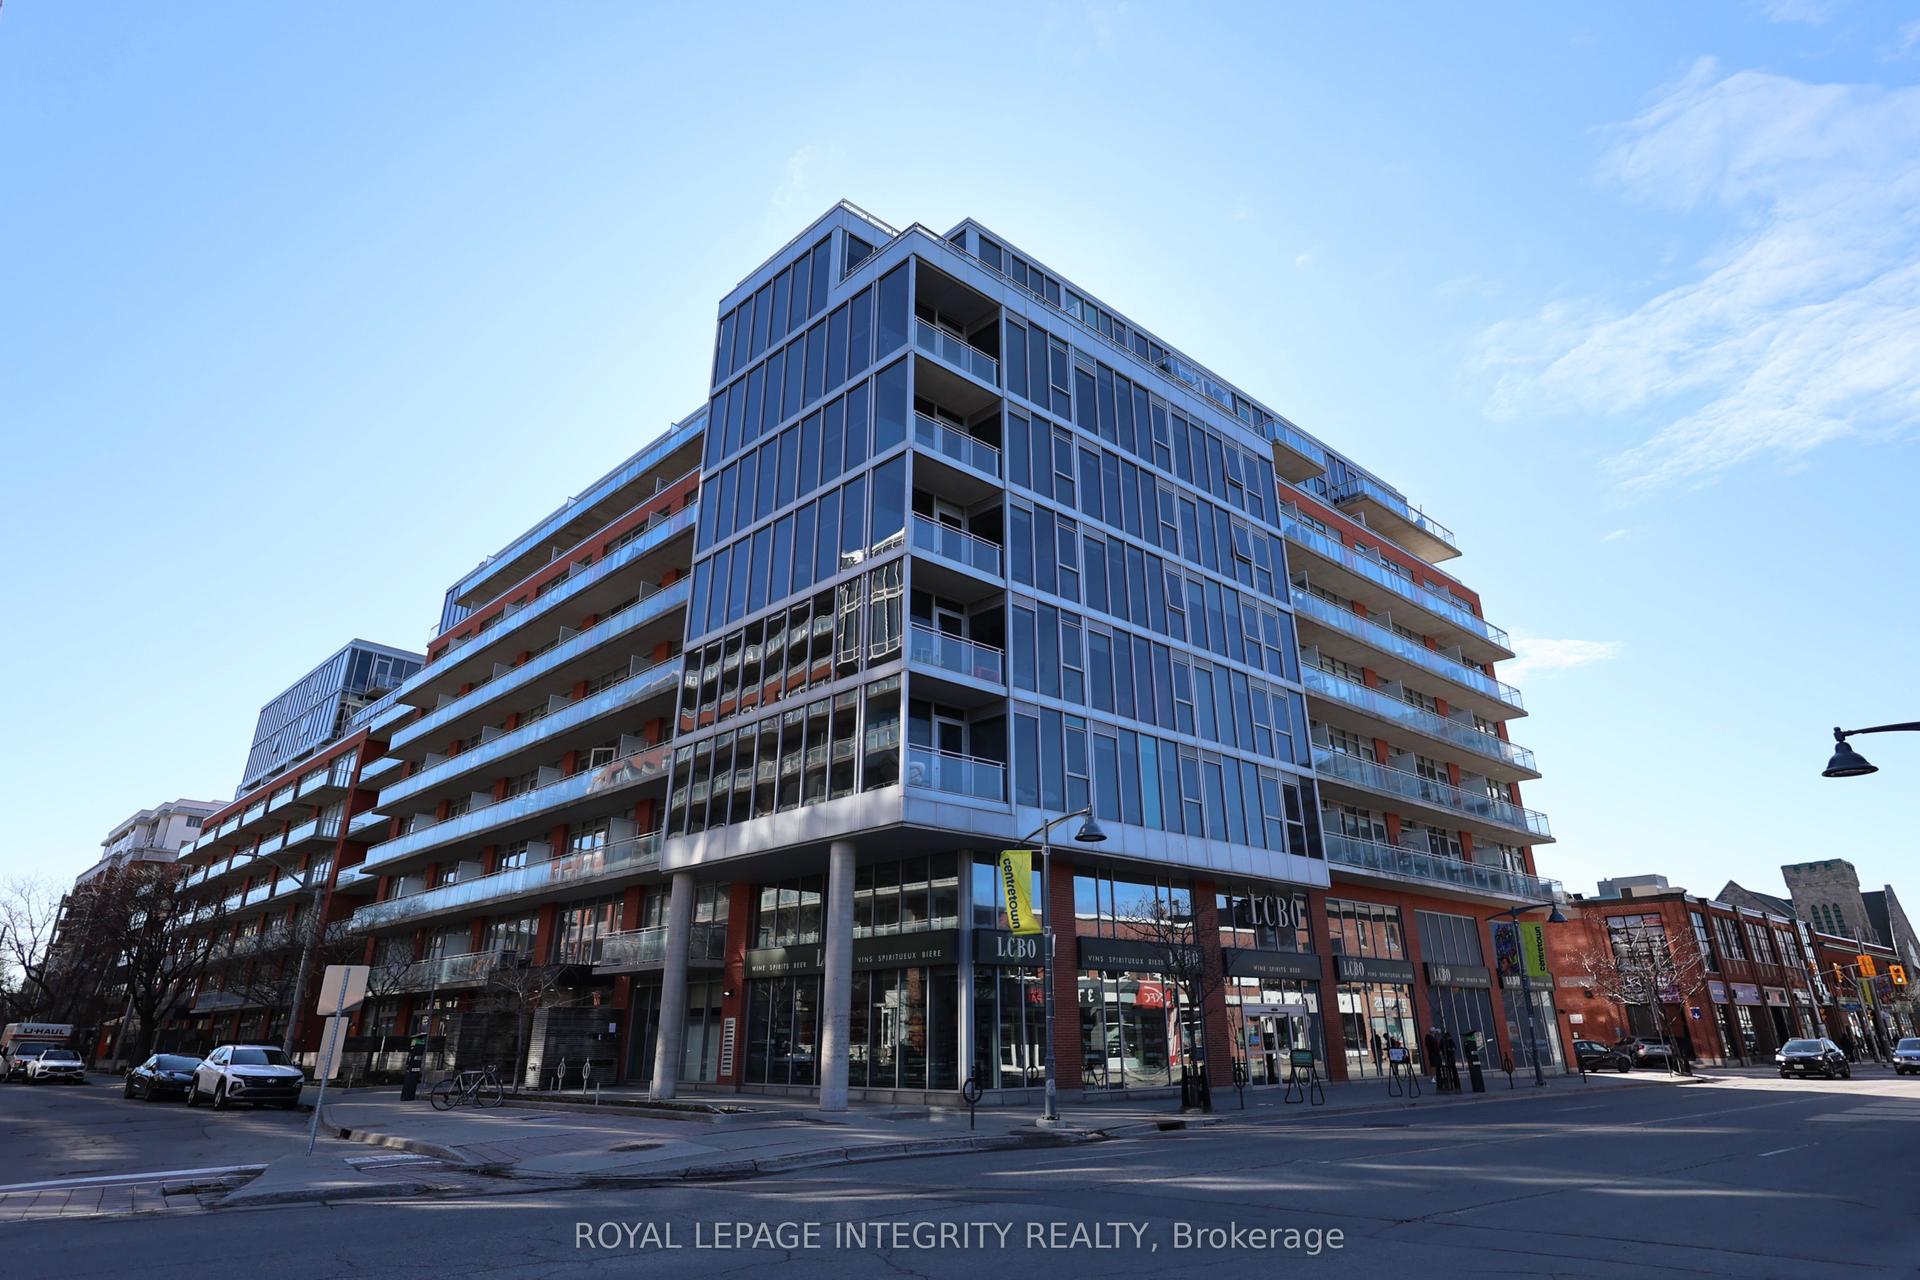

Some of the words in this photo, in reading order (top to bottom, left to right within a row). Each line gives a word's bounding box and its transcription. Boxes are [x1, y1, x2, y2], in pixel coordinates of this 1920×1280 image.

[1003, 858, 1020, 929] centretown
[1250, 894, 1301, 929] LCBO
[857, 955, 873, 963] VINS
[878, 952, 917, 961] SPIRITUEUX
[996, 936, 1036, 959] LCBO
[1343, 960, 1365, 976] LCBO
